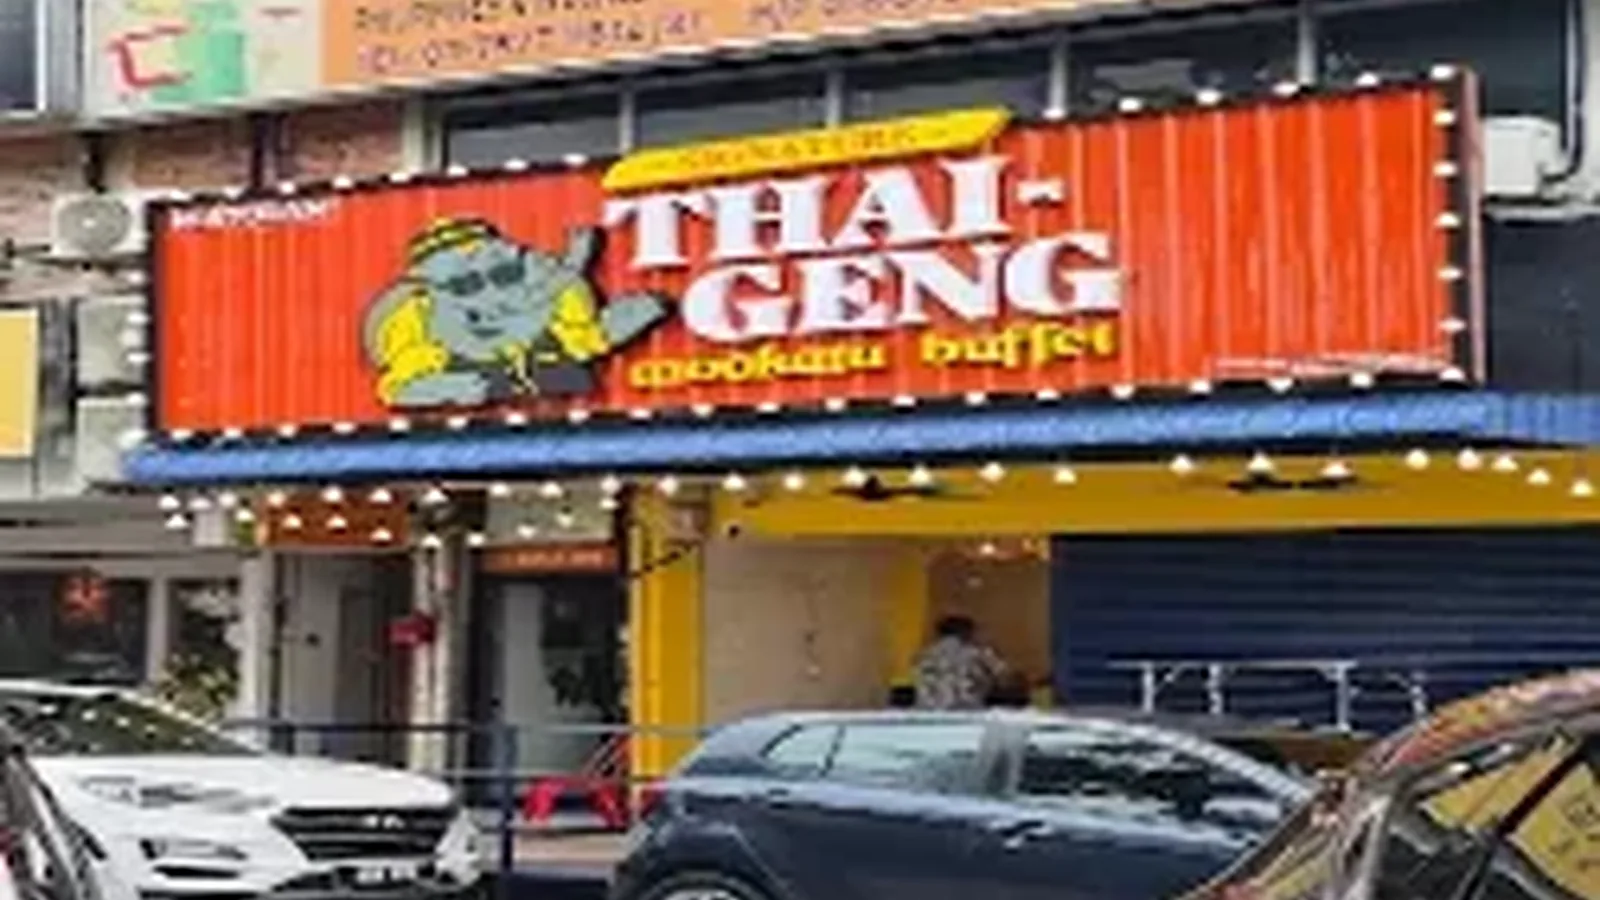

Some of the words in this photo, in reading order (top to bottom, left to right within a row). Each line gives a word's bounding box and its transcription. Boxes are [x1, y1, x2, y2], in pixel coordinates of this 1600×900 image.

[602, 156, 1065, 269] THAI-
[681, 231, 1124, 342] GENG
[921, 322, 1118, 367] buffet
